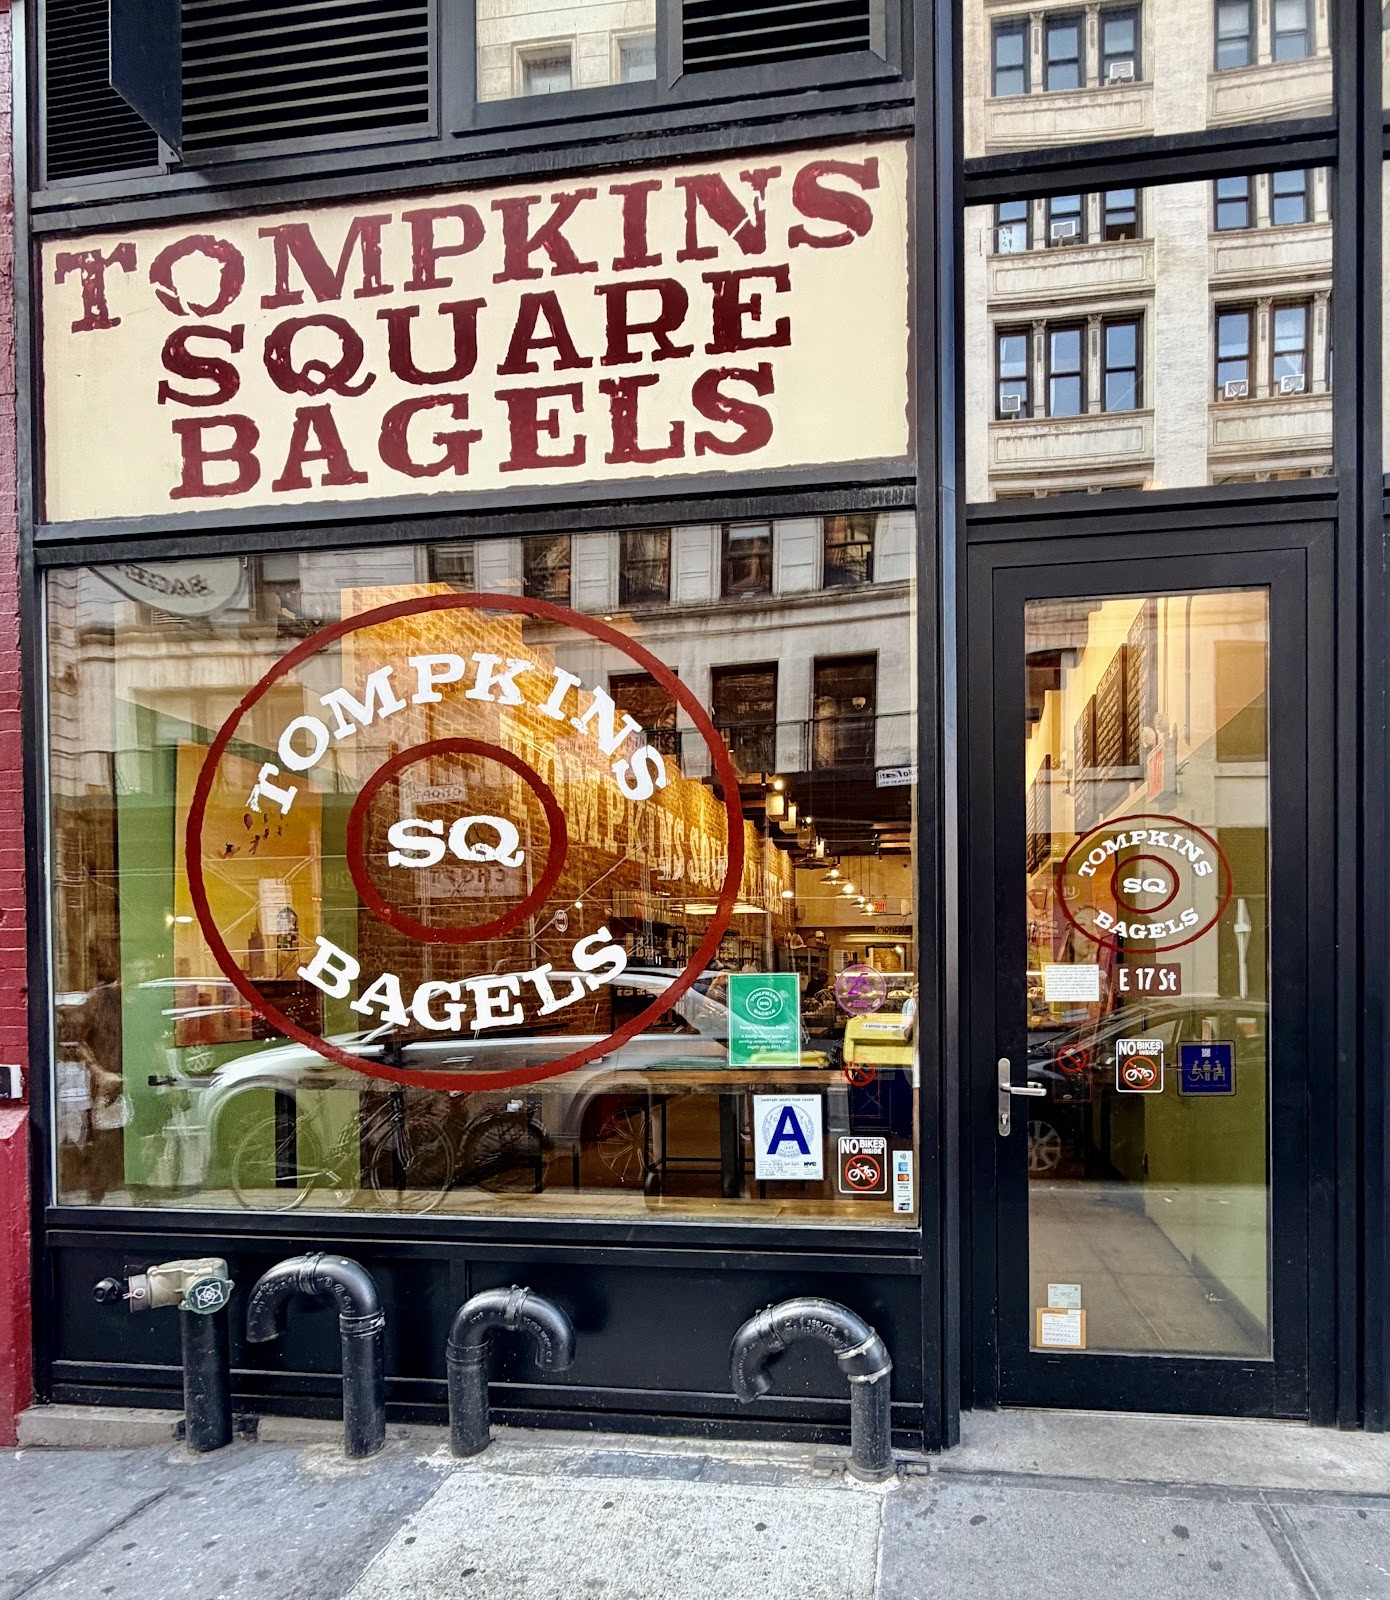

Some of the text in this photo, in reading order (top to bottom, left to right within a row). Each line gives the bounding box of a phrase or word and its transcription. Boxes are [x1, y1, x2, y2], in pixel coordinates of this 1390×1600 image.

[55, 157, 881, 332] TOMPKINS
[157, 264, 792, 406] SQUARE
[169, 361, 775, 500] BAGELS
[245, 652, 670, 815] TOMPKINS
[387, 814, 525, 868] SQ
[1077, 829, 1213, 877] TOMPKINS
[1122, 877, 1168, 894] SQ
[1092, 907, 1200, 939] BAGELS
[297, 926, 627, 1032] BAGELS
[1119, 968, 1130, 991] E
[1135, 968, 1155, 990] 17
[1158, 967, 1177, 991] St
[1118, 1041, 1161, 1056] NO BIKES
[766, 1105, 811, 1155] A
[840, 1138, 884, 1155] NO BIKES
